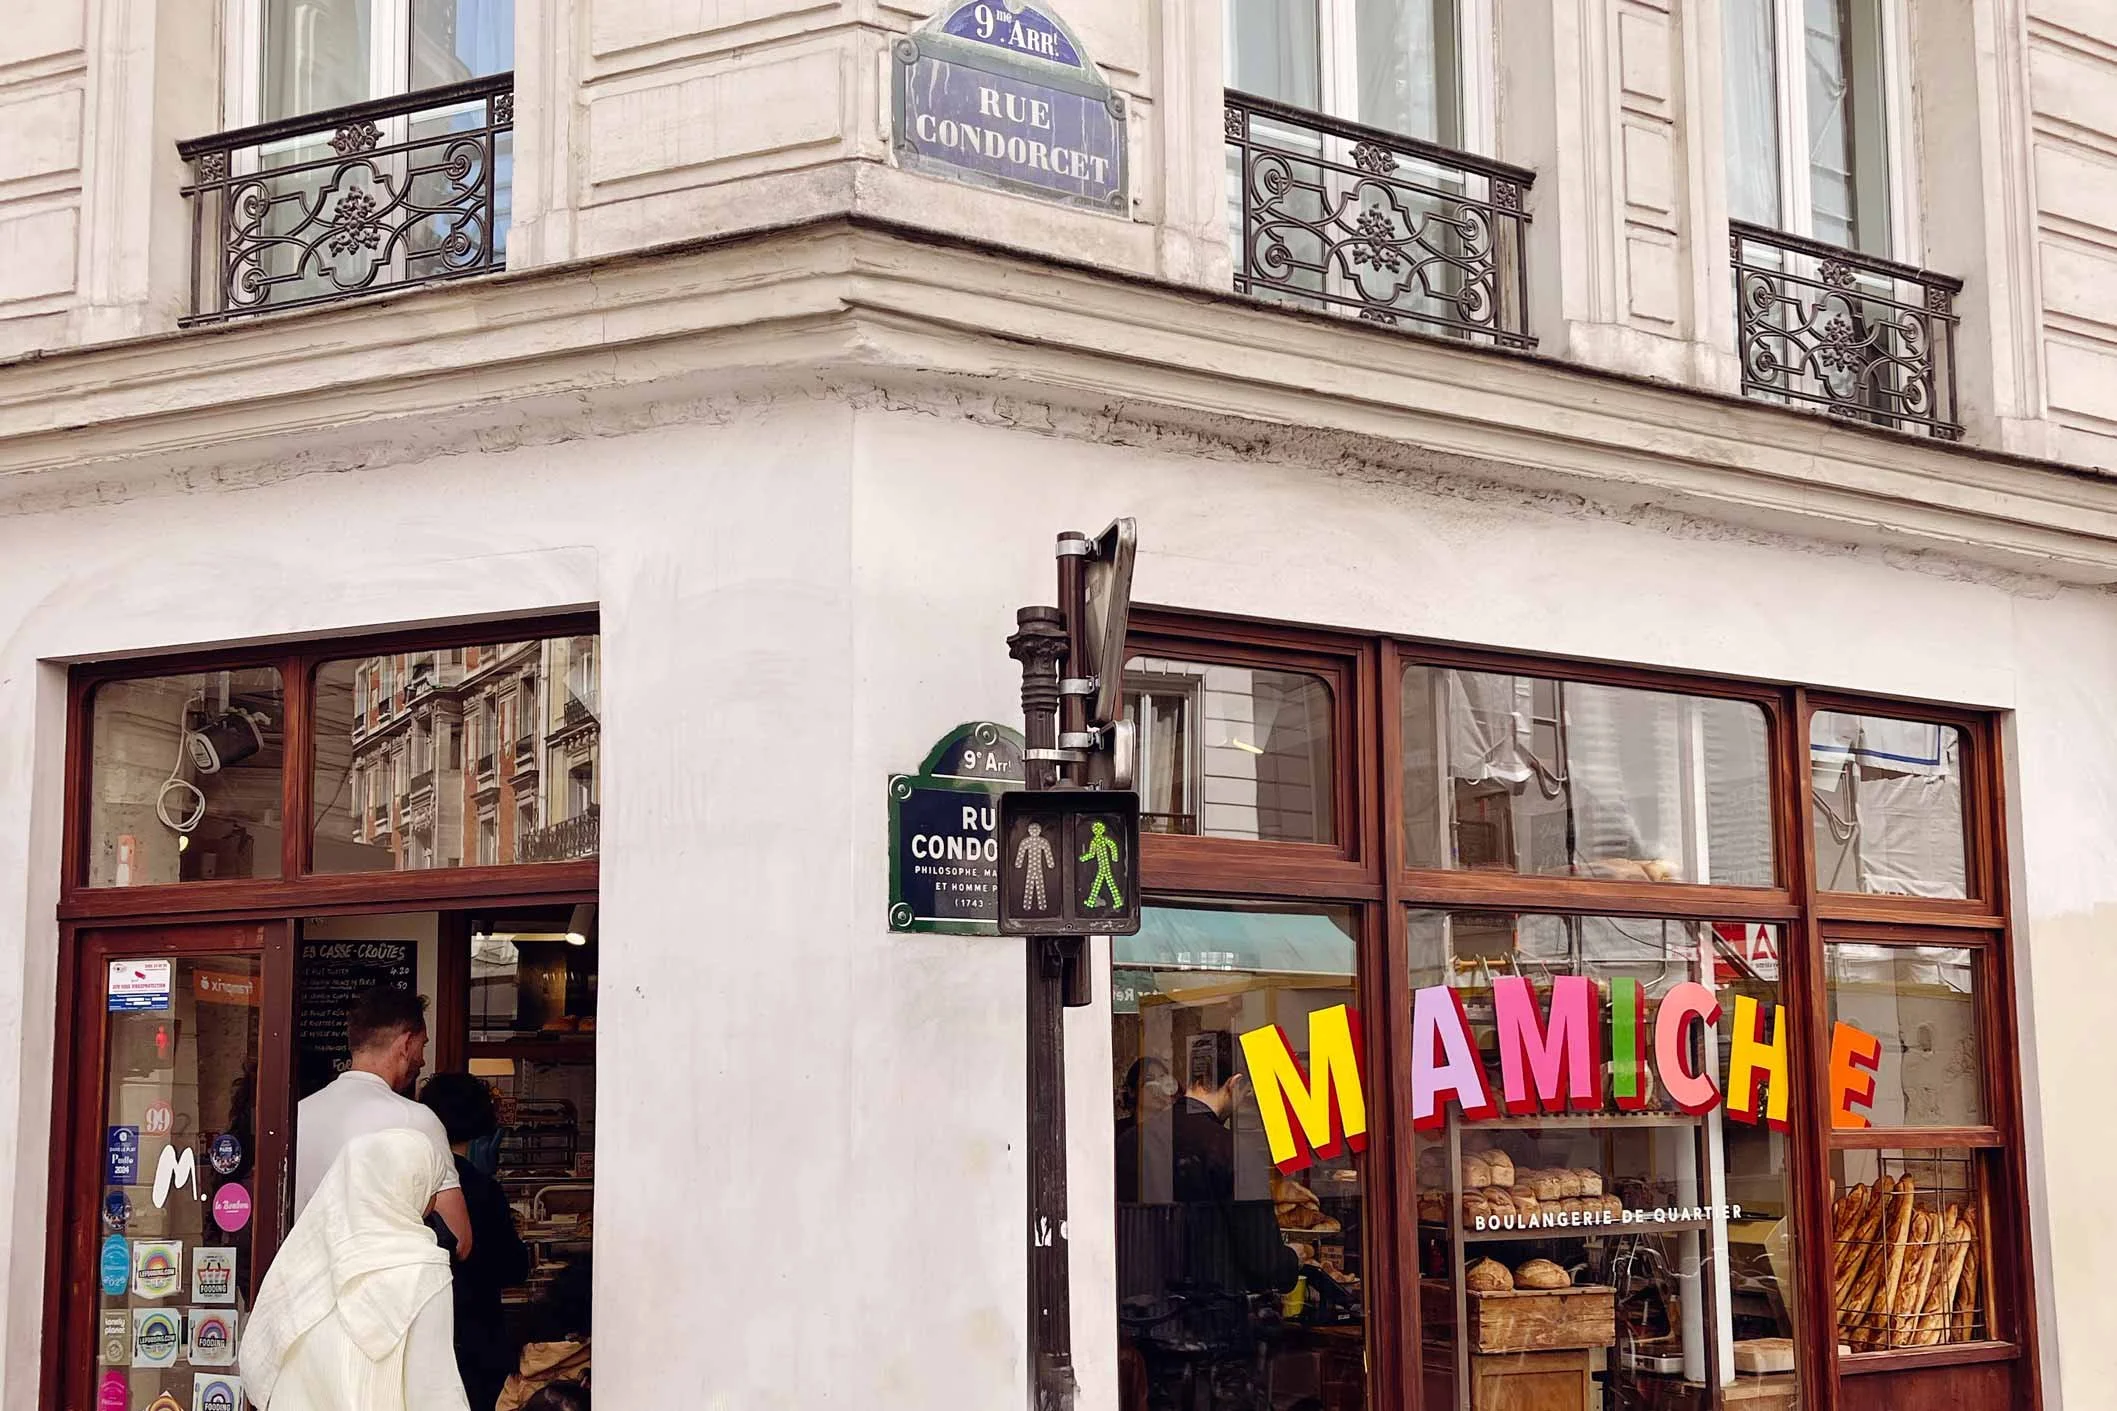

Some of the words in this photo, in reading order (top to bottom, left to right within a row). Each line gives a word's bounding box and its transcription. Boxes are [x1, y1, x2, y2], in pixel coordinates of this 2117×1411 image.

[978, 86, 1050, 129] RUE
[915, 113, 1109, 184] CONDORCET
[936, 882, 947, 891] ET
[952, 883, 988, 892] HOMME
[955, 898, 984, 908] (1743
[1238, 975, 1882, 1176] MAMICHE
[1475, 1209, 1613, 1231] BOULANGERIE
[1621, 1208, 1644, 1224] DE
[1653, 1204, 1743, 1224] QUARTIER
